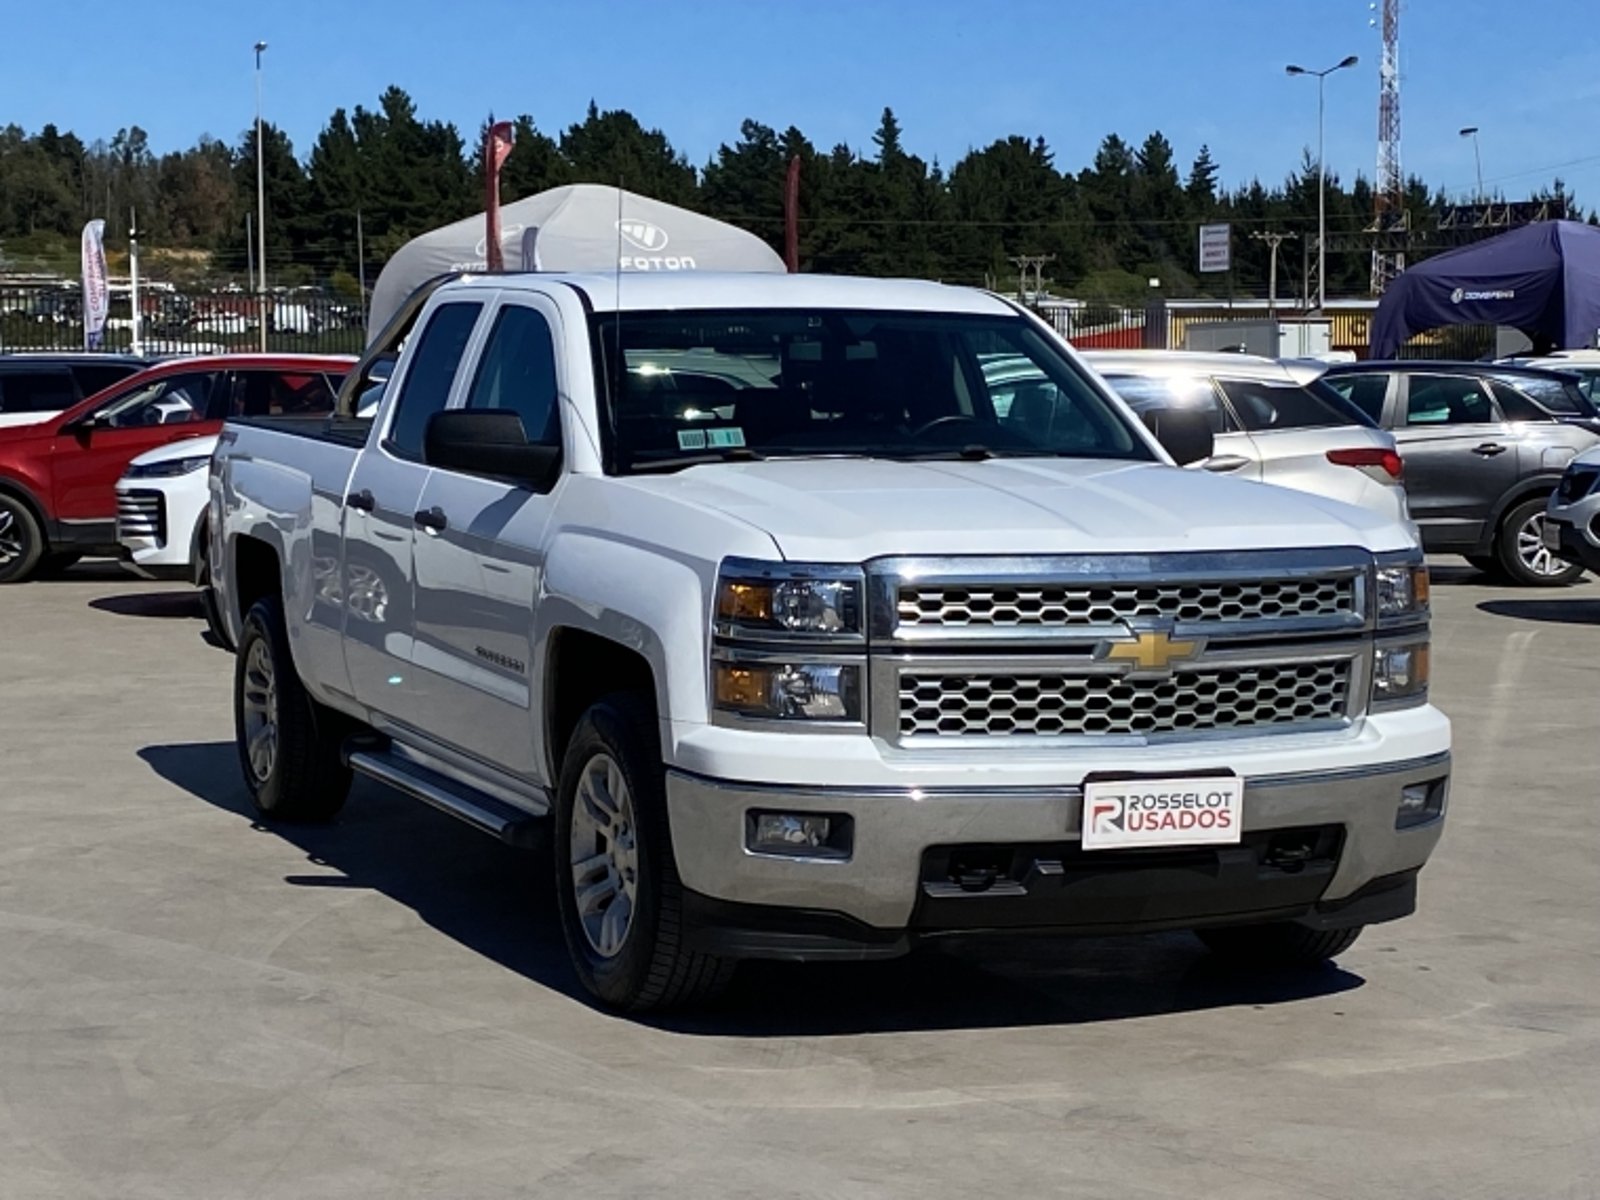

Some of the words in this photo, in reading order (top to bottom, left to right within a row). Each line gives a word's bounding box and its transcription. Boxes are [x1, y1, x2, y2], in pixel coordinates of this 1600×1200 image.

[619, 256, 696, 271] FOTON
[1128, 792, 1233, 811] ROSSELOT
[1128, 809, 1232, 832] USADOS
